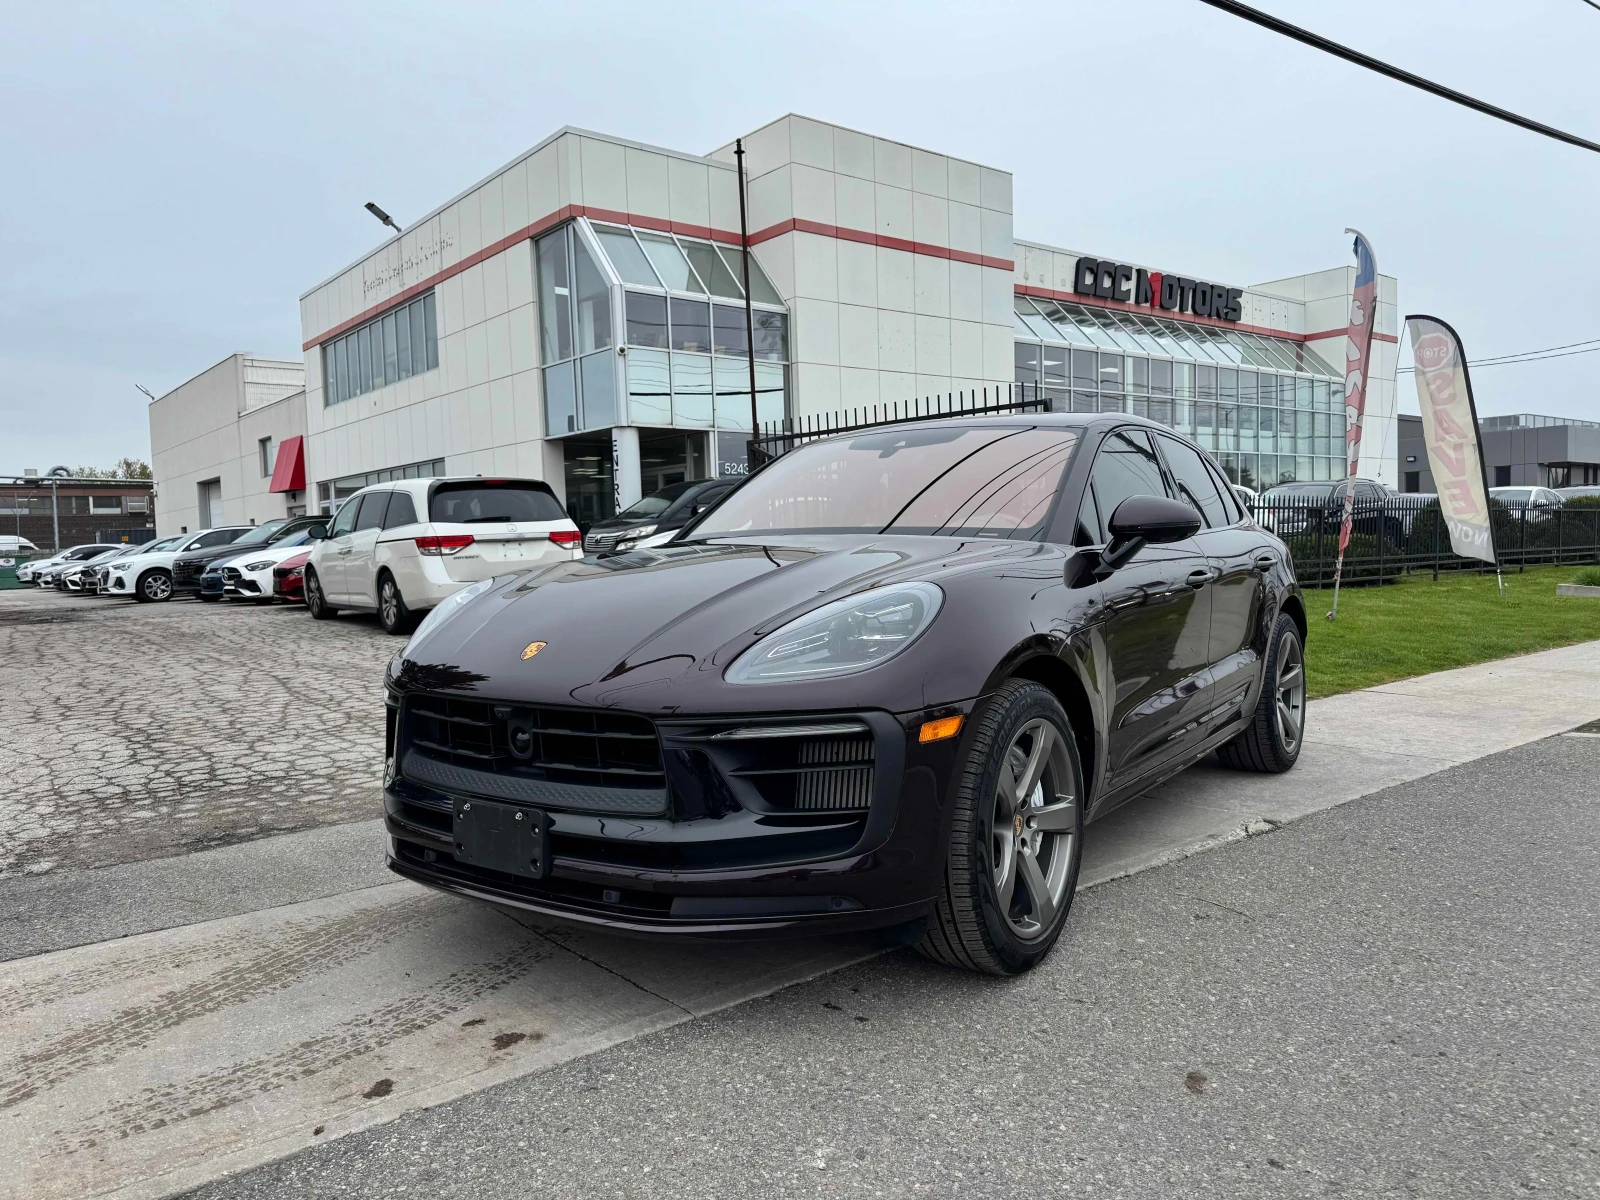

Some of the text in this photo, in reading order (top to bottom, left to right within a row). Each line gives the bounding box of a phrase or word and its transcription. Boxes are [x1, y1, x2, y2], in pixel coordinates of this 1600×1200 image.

[1074, 256, 1243, 321] CCC MOTORS
[612, 439, 622, 515] ENTRA
[724, 462, 749, 475] 5243
